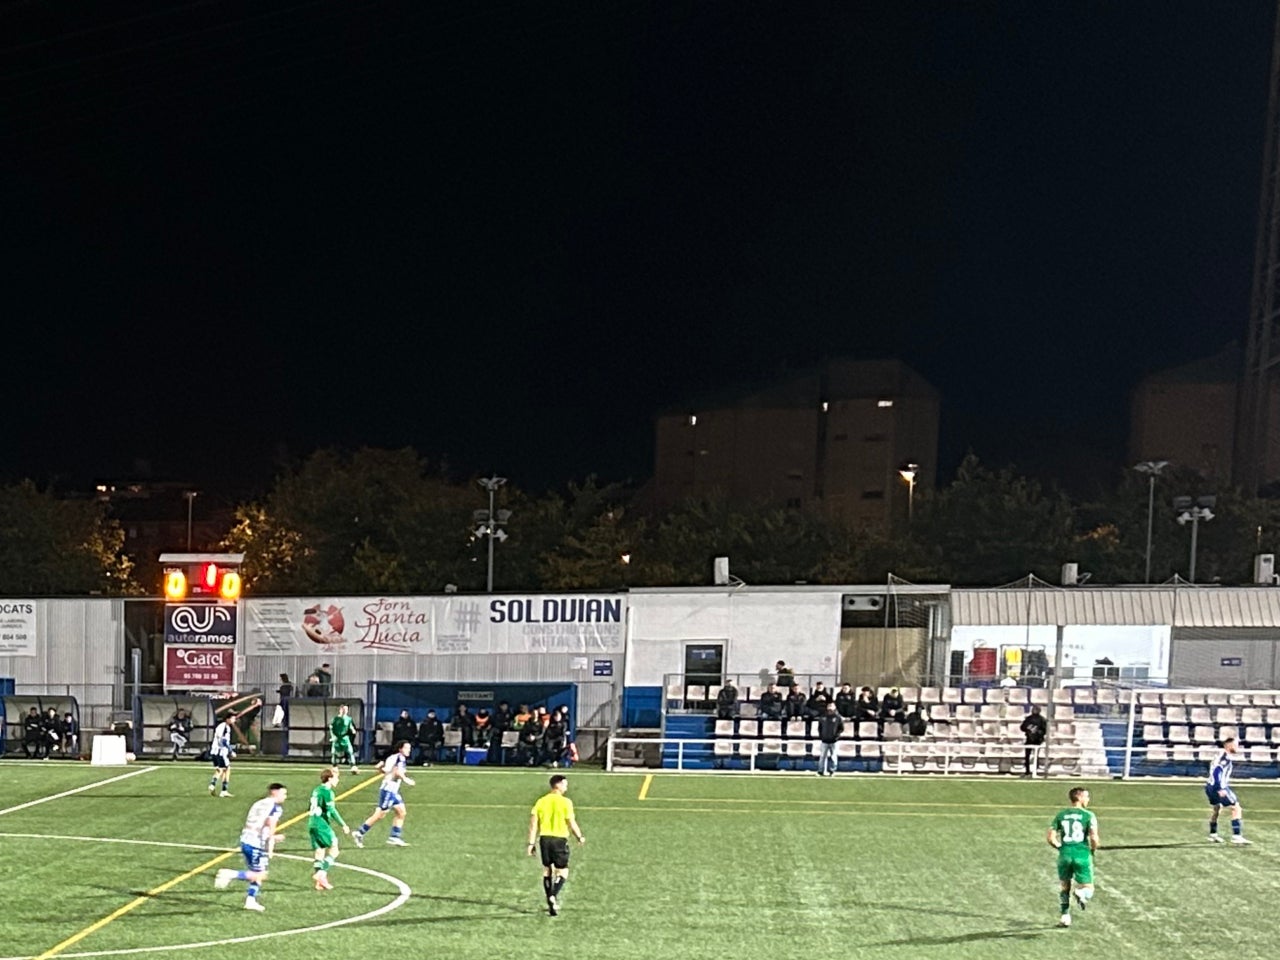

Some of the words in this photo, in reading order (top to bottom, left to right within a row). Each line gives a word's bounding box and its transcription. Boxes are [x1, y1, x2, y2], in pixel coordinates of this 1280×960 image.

[167, 571, 186, 599] 0
[221, 572, 241, 599] 0
[355, 602, 428, 627] Santa
[167, 633, 234, 643] autoramos
[1061, 819, 1085, 843] 18
